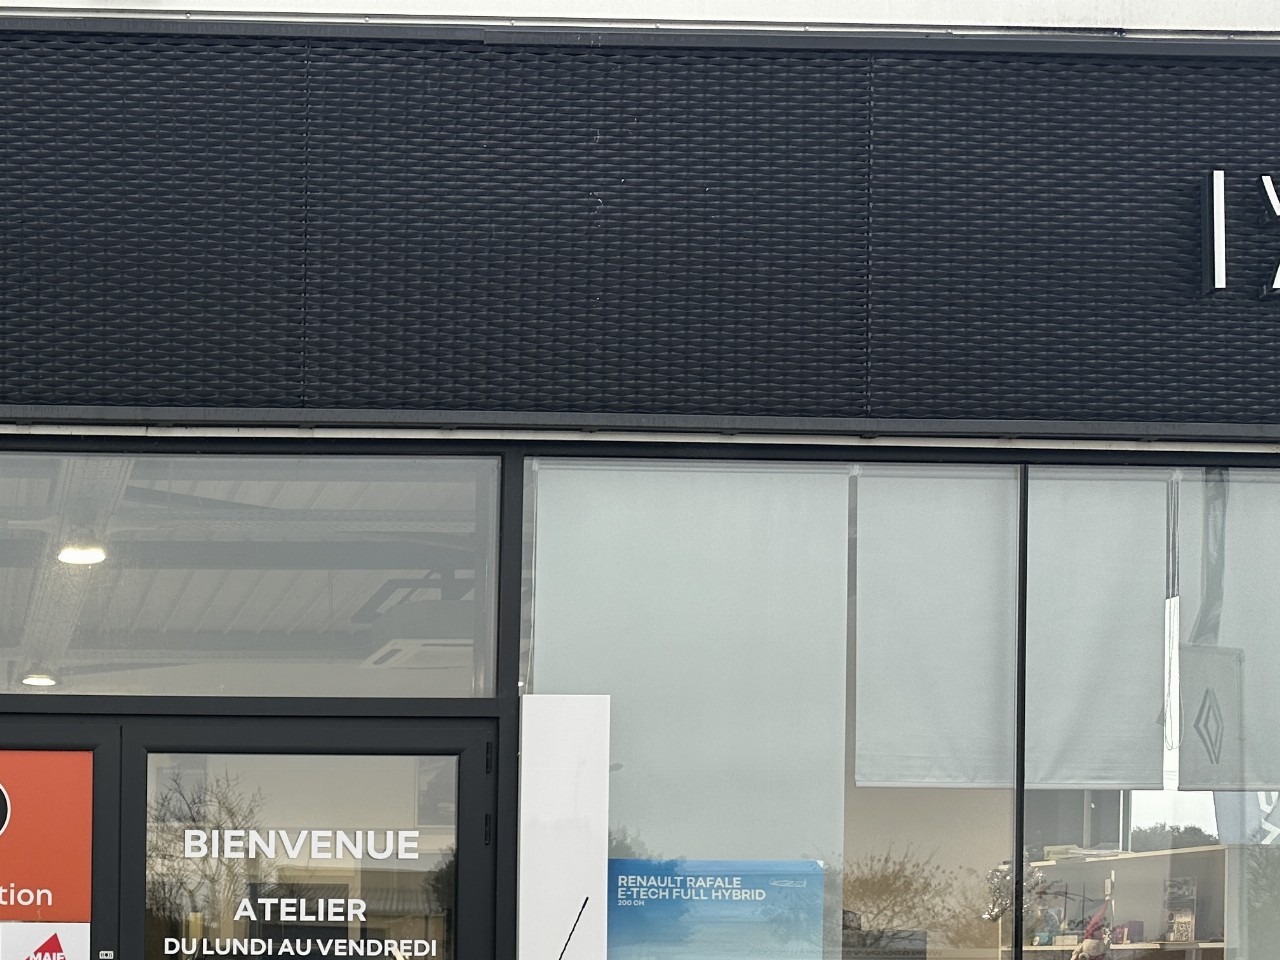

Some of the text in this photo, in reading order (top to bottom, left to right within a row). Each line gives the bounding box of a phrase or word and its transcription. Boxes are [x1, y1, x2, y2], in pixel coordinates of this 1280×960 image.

[184, 829, 420, 860] BIENVENUE
[617, 875, 742, 889] RENAULT RAFALE
[617, 887, 766, 901] E-TECH FULL HYBRID
[233, 898, 367, 922] ATELIER
[163, 938, 438, 957] DU LUNDI AU VENDREDI
